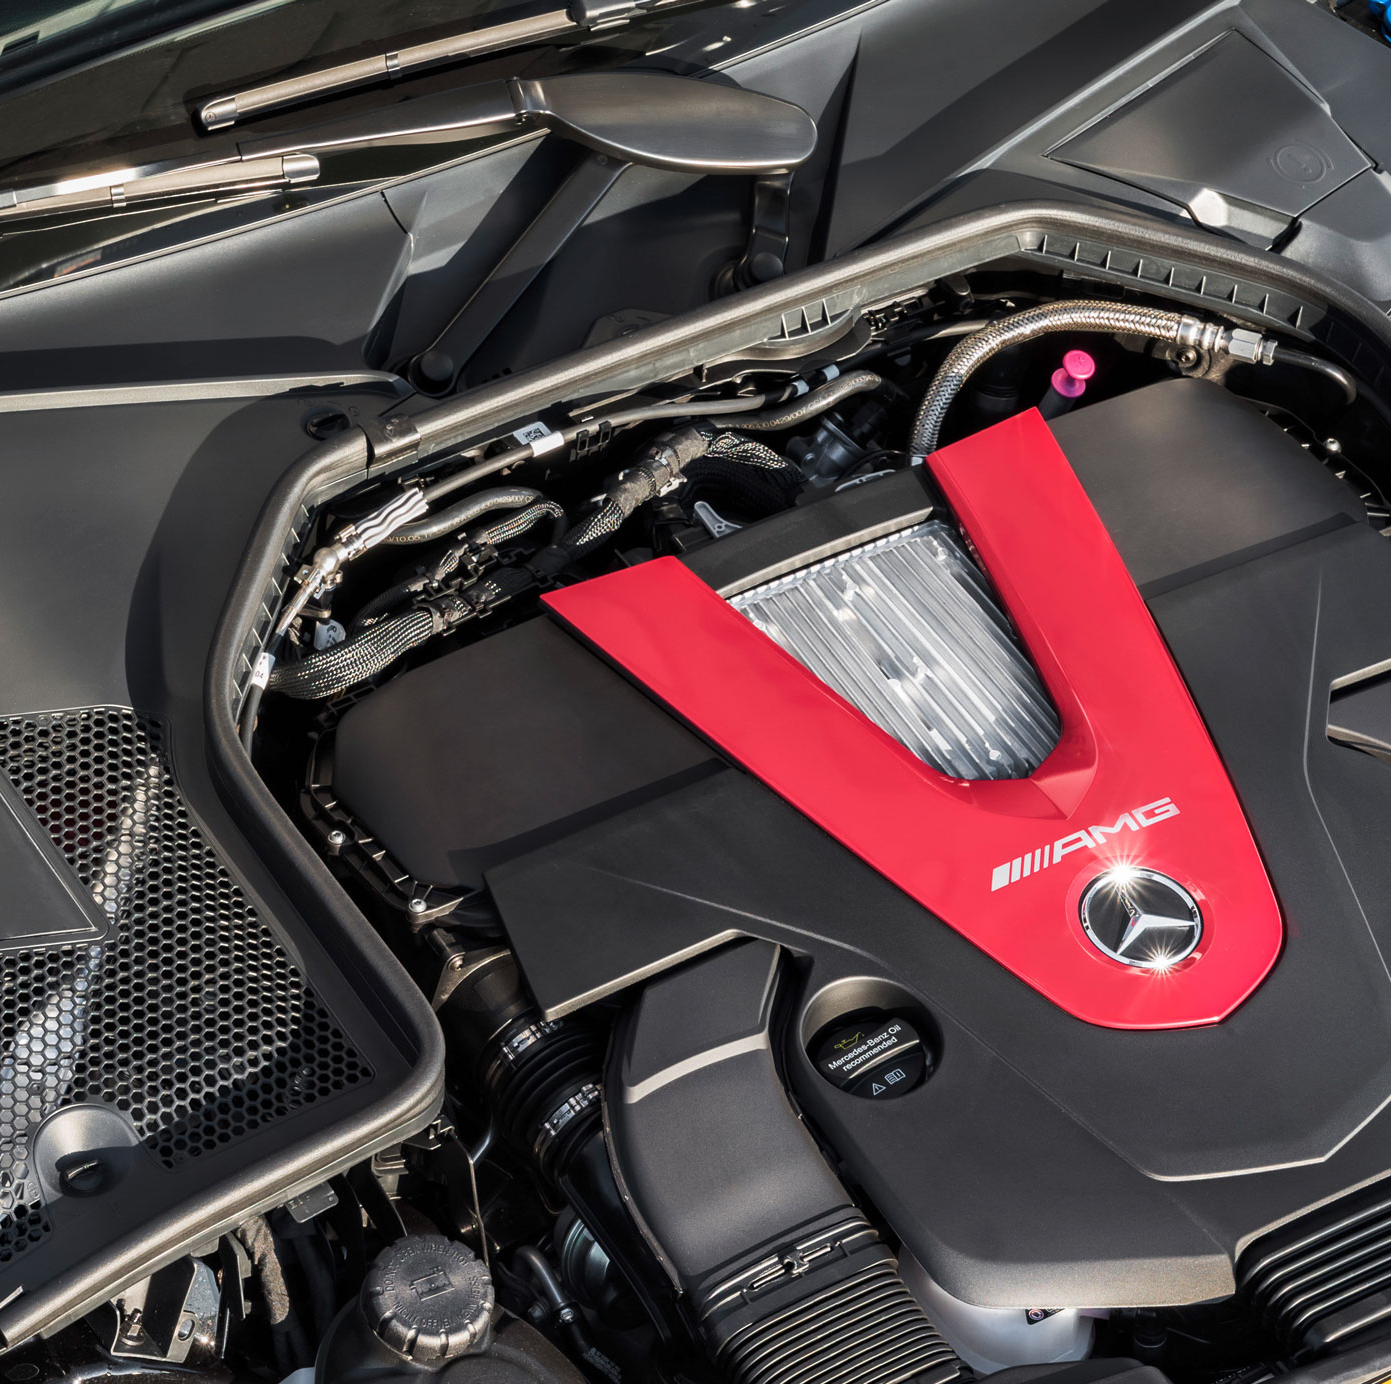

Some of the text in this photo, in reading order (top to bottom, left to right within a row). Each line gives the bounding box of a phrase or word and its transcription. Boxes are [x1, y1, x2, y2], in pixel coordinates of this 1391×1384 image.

[1052, 797, 1181, 865] AMG
[828, 1024, 902, 1070] Mercedes-Benz Oil
[842, 1036, 898, 1071] recommended
